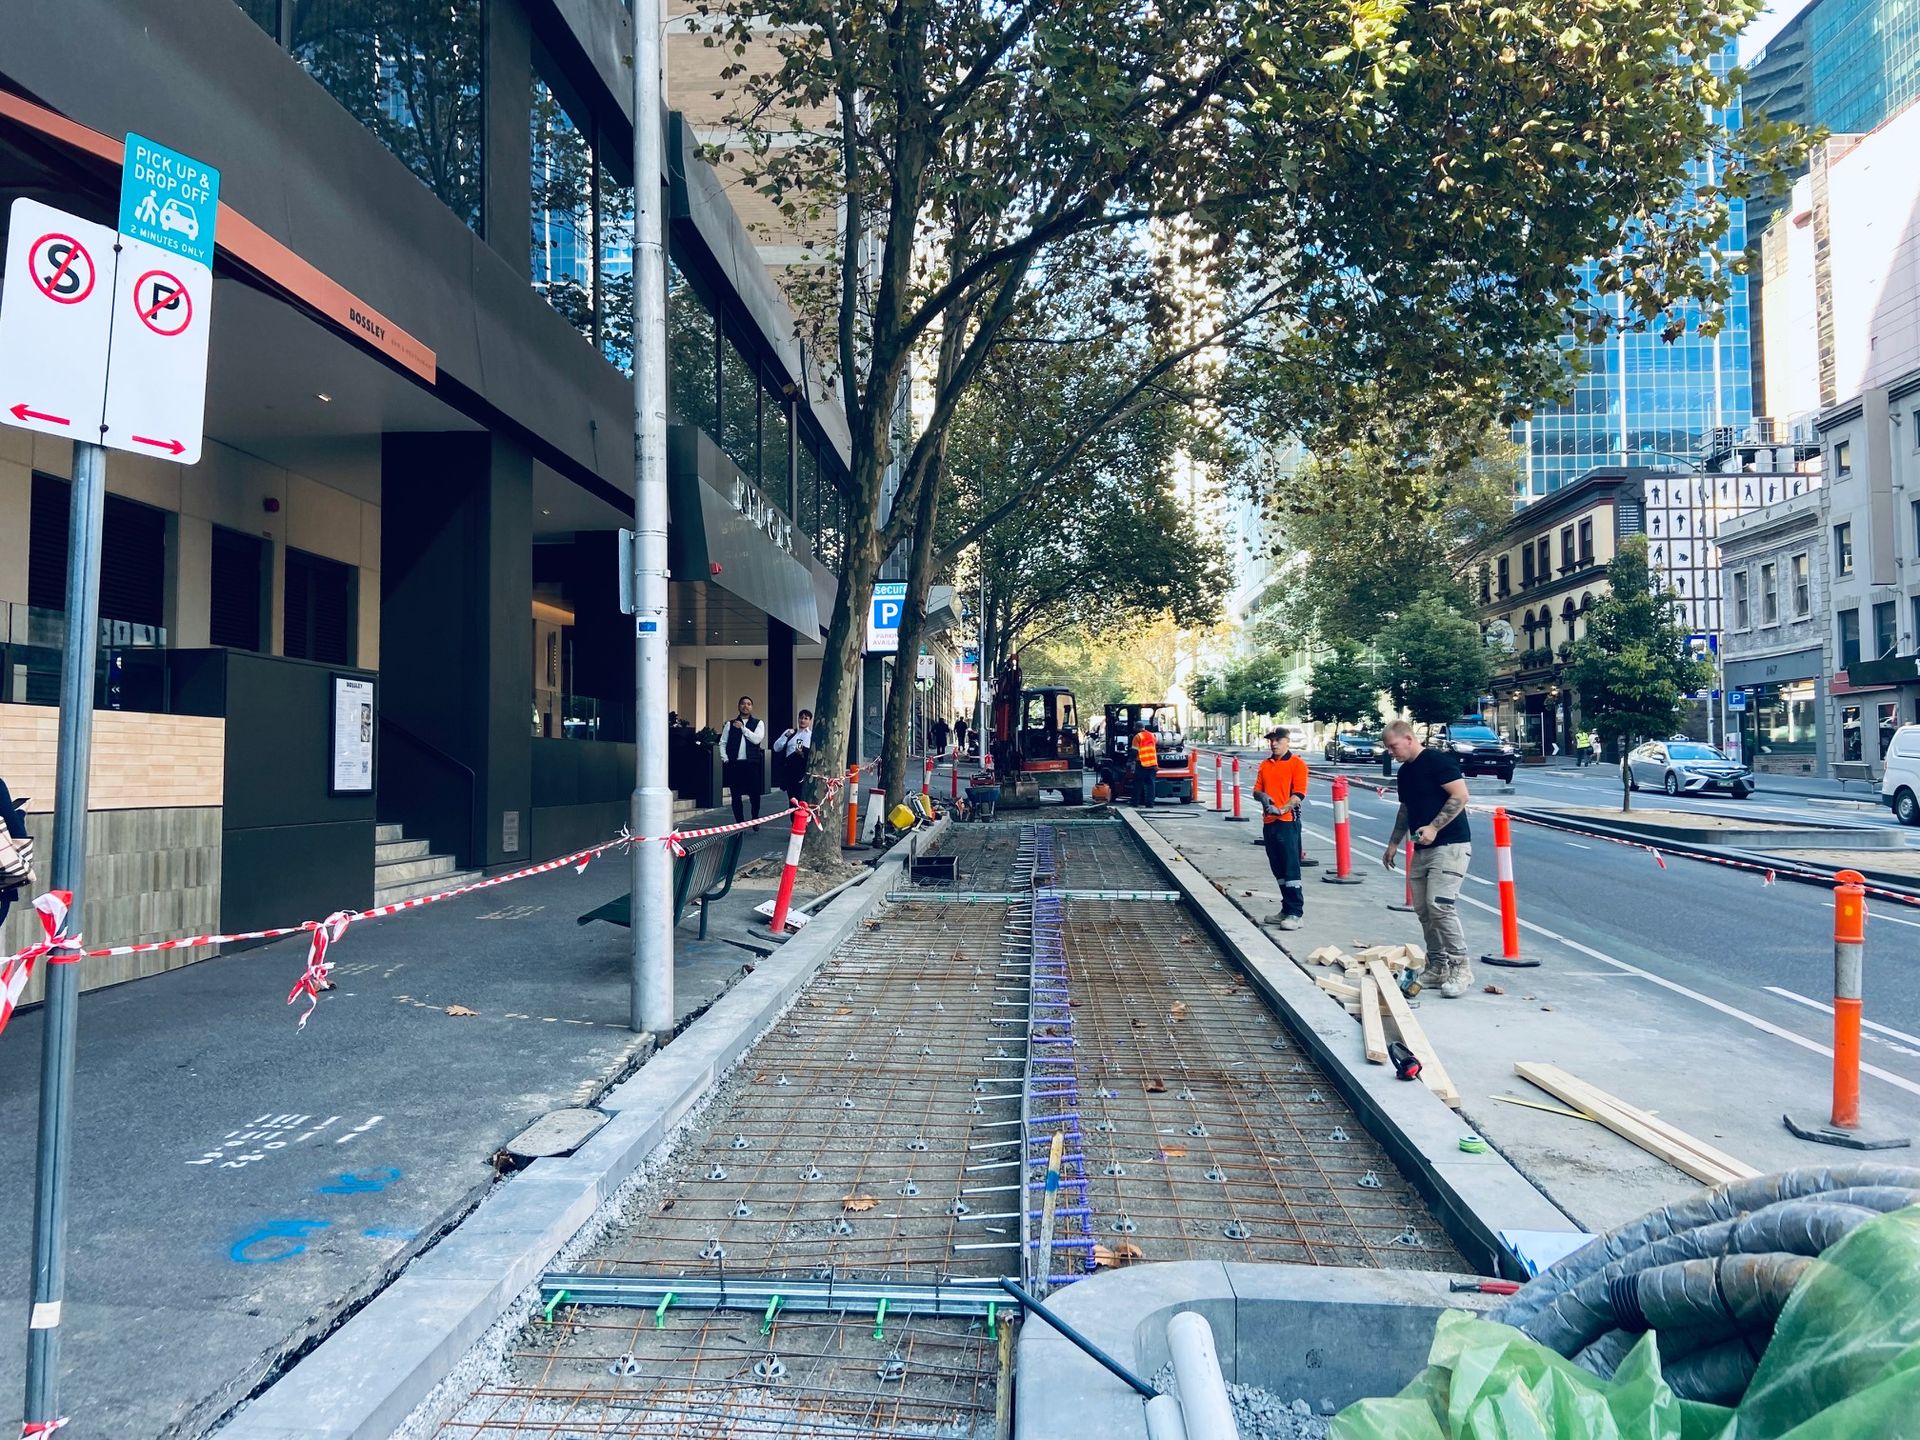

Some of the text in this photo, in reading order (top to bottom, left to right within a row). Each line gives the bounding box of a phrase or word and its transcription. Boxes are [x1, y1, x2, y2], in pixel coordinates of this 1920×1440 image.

[134, 163, 210, 205] DROP OFF
[136, 145, 210, 190] PICK UP &
[130, 224, 205, 259] 2 MINUTES ONLY
[43, 243, 80, 295] S
[151, 282, 180, 320] P
[349, 307, 385, 341] BOSSLEY
[882, 602, 898, 625] P
[1732, 693, 1741, 704] P
